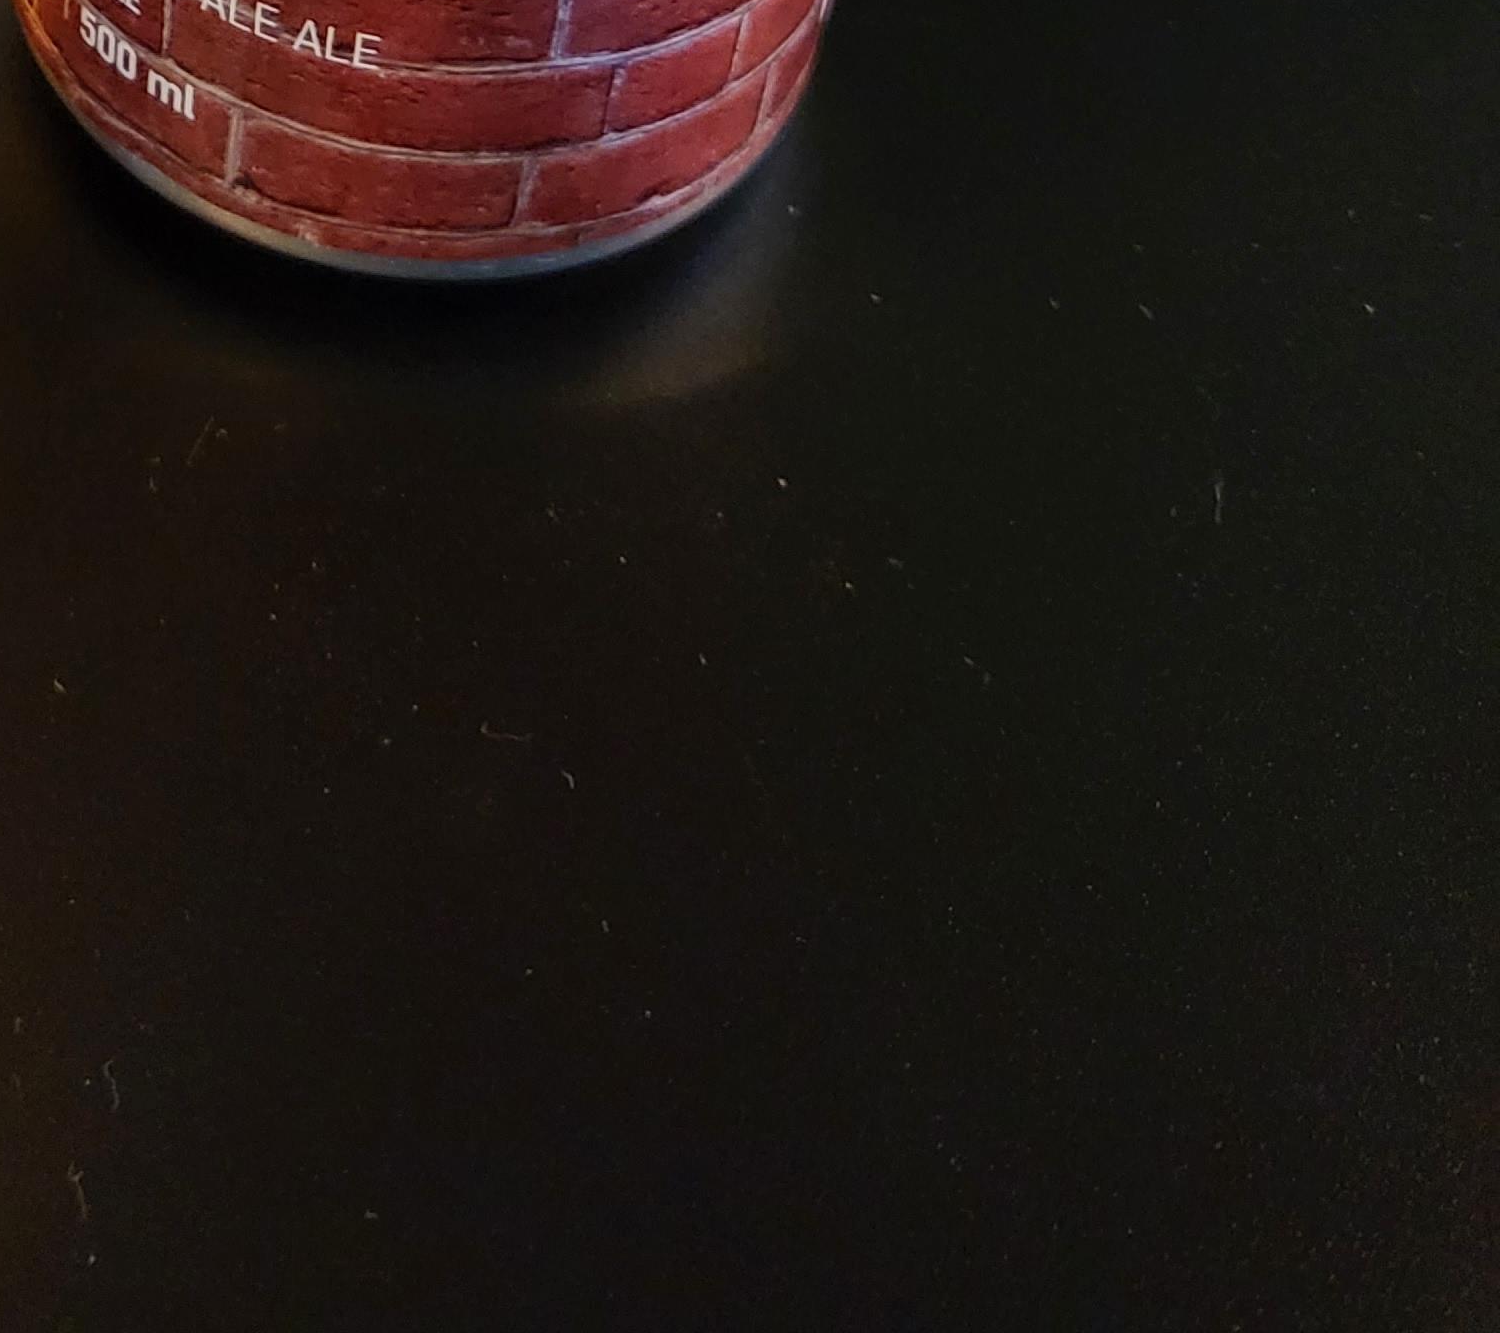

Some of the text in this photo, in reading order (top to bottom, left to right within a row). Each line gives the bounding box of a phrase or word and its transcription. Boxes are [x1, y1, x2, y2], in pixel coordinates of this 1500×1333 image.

[78, 5, 138, 82] 500
[146, 69, 197, 122] ml
[293, 19, 382, 70] ALE
